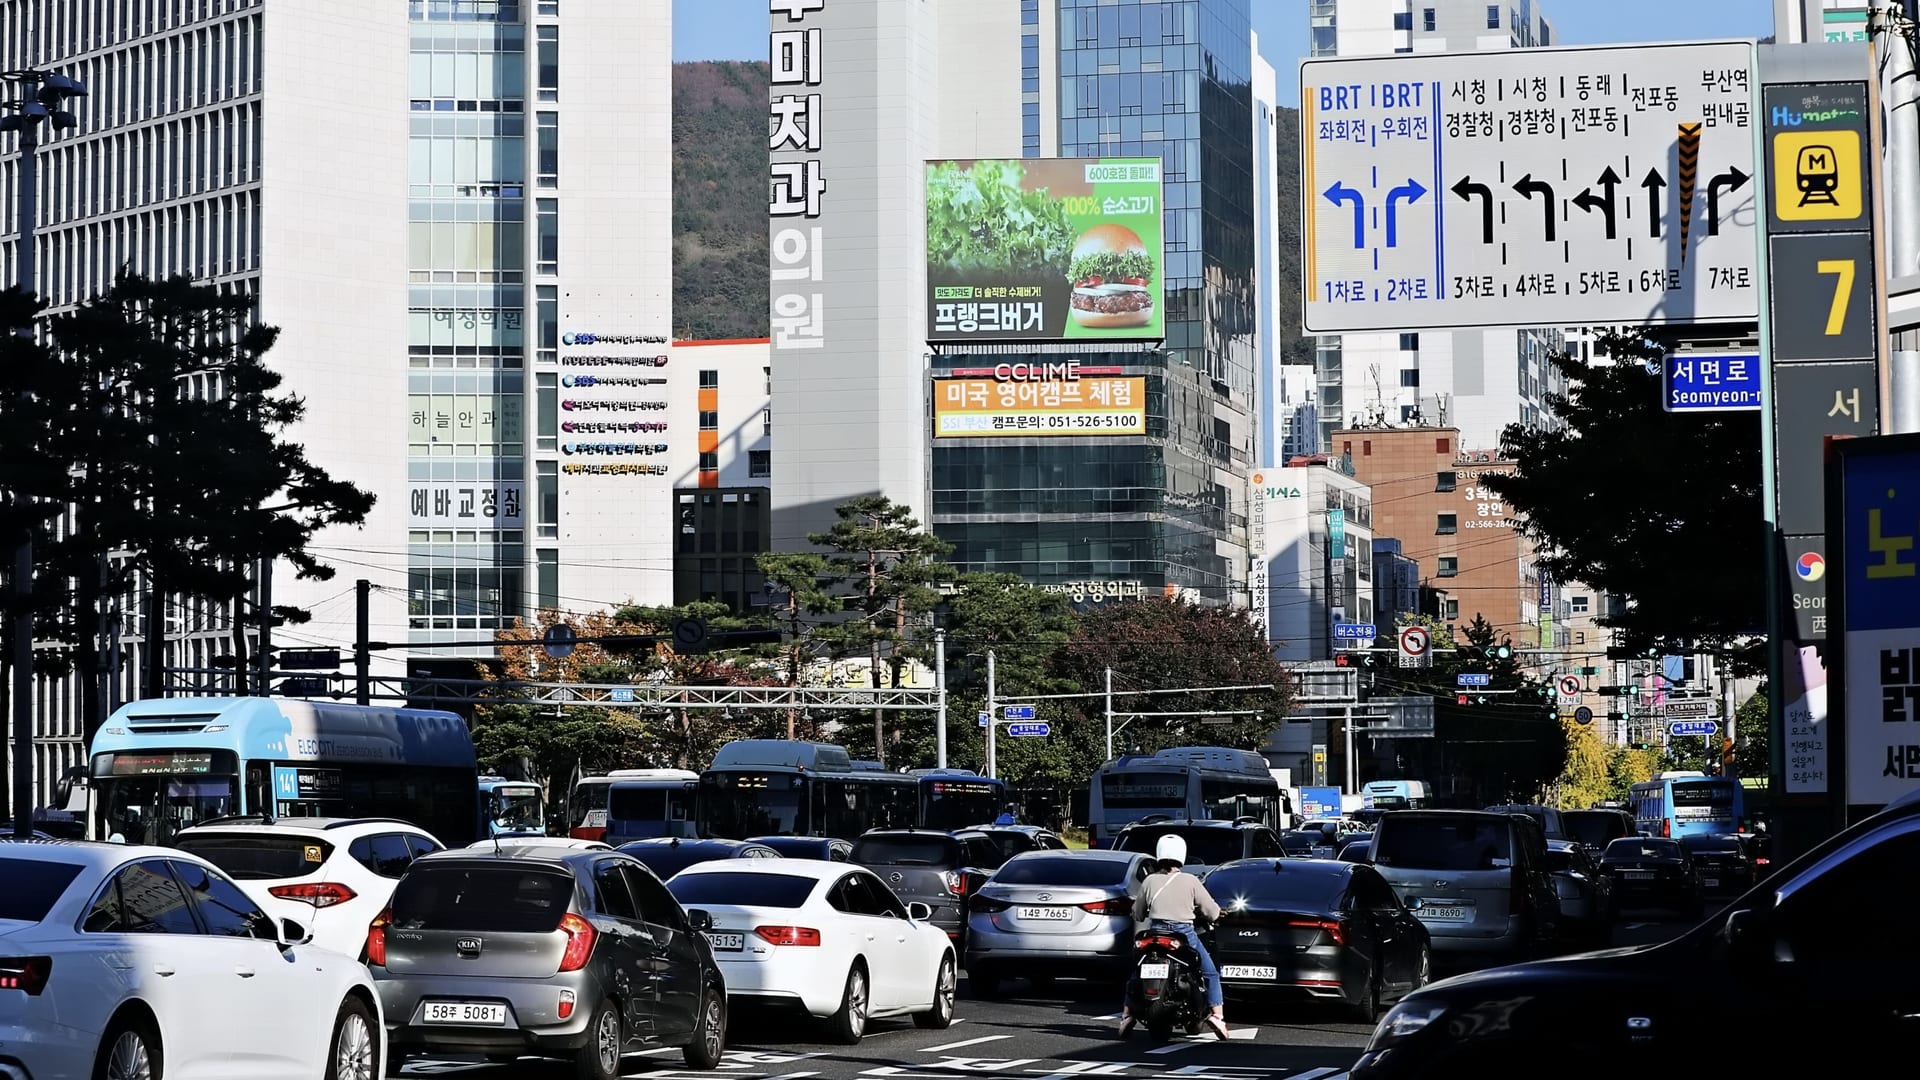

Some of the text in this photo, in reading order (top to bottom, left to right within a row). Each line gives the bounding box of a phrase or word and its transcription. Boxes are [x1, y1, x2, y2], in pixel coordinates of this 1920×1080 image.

[1451, 80, 1486, 104] 시청
[1513, 77, 1548, 102] 시청
[1576, 74, 1612, 100] 동래
[1701, 69, 1749, 93] 부산역
[1321, 86, 1362, 111] BRT
[1382, 83, 1424, 108] BRT
[1631, 86, 1679, 112] 전포동
[1446, 111, 1494, 138] 경찰청
[1507, 109, 1555, 136] 경찰청
[1571, 108, 1618, 133] 전포동
[1702, 102, 1750, 128] 범내골
[1772, 106, 1859, 127] Humet
[1319, 119, 1366, 142] 좌회전
[1381, 116, 1428, 140] 우회전
[1063, 195, 1155, 216] 100% 순소고기
[1387, 279, 1428, 301] 2차로
[1454, 276, 1495, 299] 3차로
[1516, 273, 1557, 297] 4차로
[1580, 272, 1621, 295] 5차로
[1640, 269, 1682, 293] 6차로
[1709, 267, 1751, 290] 7차로
[1325, 281, 1366, 302] 1차로
[1816, 260, 1856, 336] 7
[934, 302, 1045, 333] 프랭크버거
[1672, 360, 1750, 385] 서면로
[947, 379, 1132, 408] 미국 영어캠프 체험
[1828, 388, 1860, 422] 서
[411, 411, 497, 429] 하늘안과
[1048, 414, 1138, 429] 051-526-5100
[1252, 487, 1266, 552] 삼성피부과
[1477, 502, 1504, 517] 장인
[1337, 626, 1374, 638] 버스전용
[279, 772, 296, 794] 141
[1044, 908, 1069, 918] 7665
[1439, 908, 1461, 917] 8690
[461, 940, 476, 948] KIA
[1251, 967, 1275, 978] 1633
[432, 1004, 497, 1021] 58주 5081
